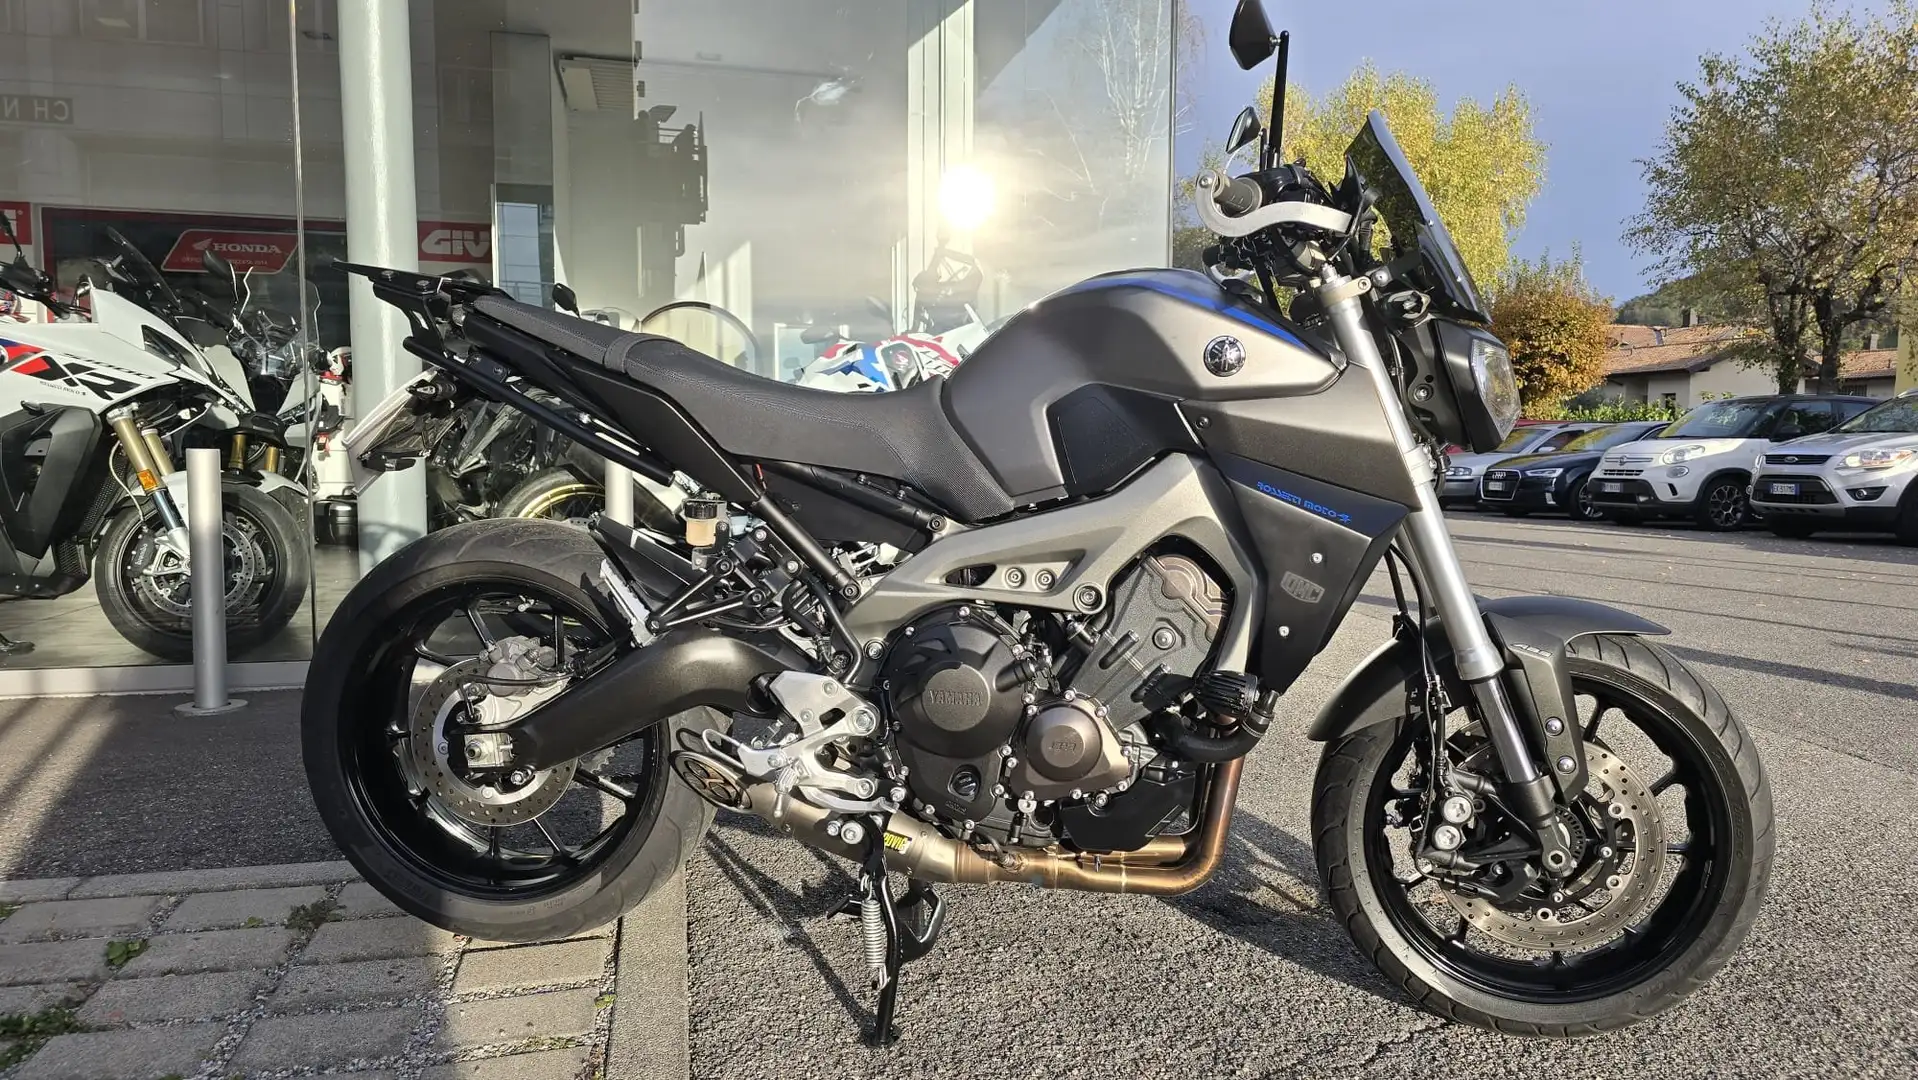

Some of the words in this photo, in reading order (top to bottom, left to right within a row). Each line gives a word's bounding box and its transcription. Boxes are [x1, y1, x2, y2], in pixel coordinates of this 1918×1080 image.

[212, 243, 281, 254] HONDA
[1257, 481, 1302, 505] ROSSETTI
[1303, 500, 1337, 518] MOTO
[928, 687, 983, 707] YAMAHA
